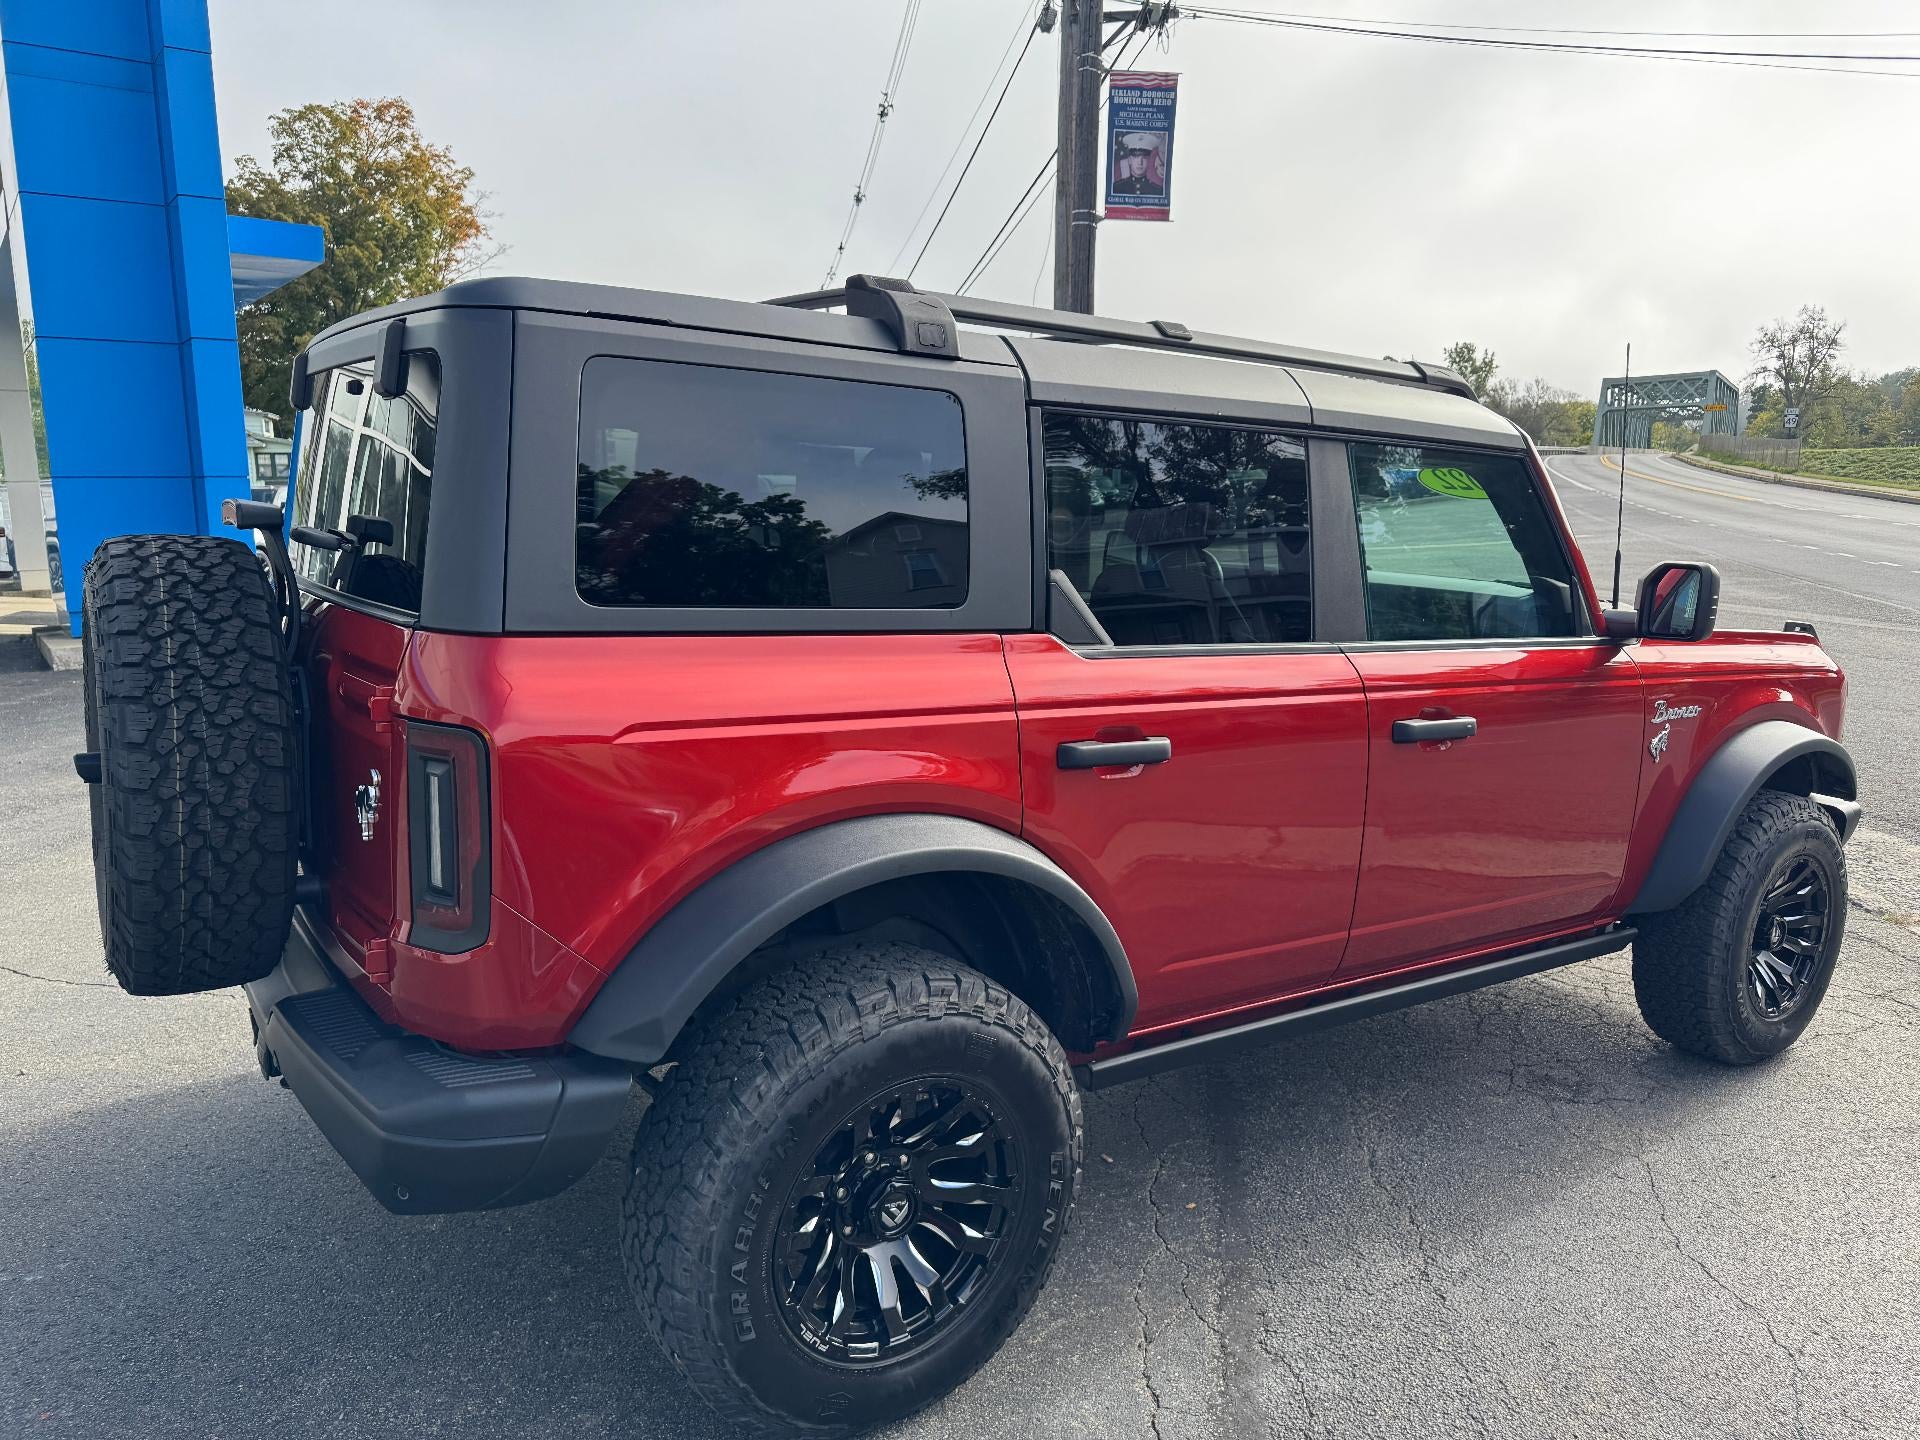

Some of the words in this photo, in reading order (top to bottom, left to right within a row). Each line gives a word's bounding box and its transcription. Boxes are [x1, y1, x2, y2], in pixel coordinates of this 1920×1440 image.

[1111, 89, 1140, 97] ELKLAND
[1142, 90, 1175, 98] BOROUGH
[1113, 97, 1152, 105] HOMETOWN
[1153, 98, 1172, 106] HERO
[1126, 119, 1149, 127] MARINE
[1785, 417, 1797, 425] 49
[1651, 700, 1702, 724] Bronco
[800, 1322, 830, 1352] FUEL
